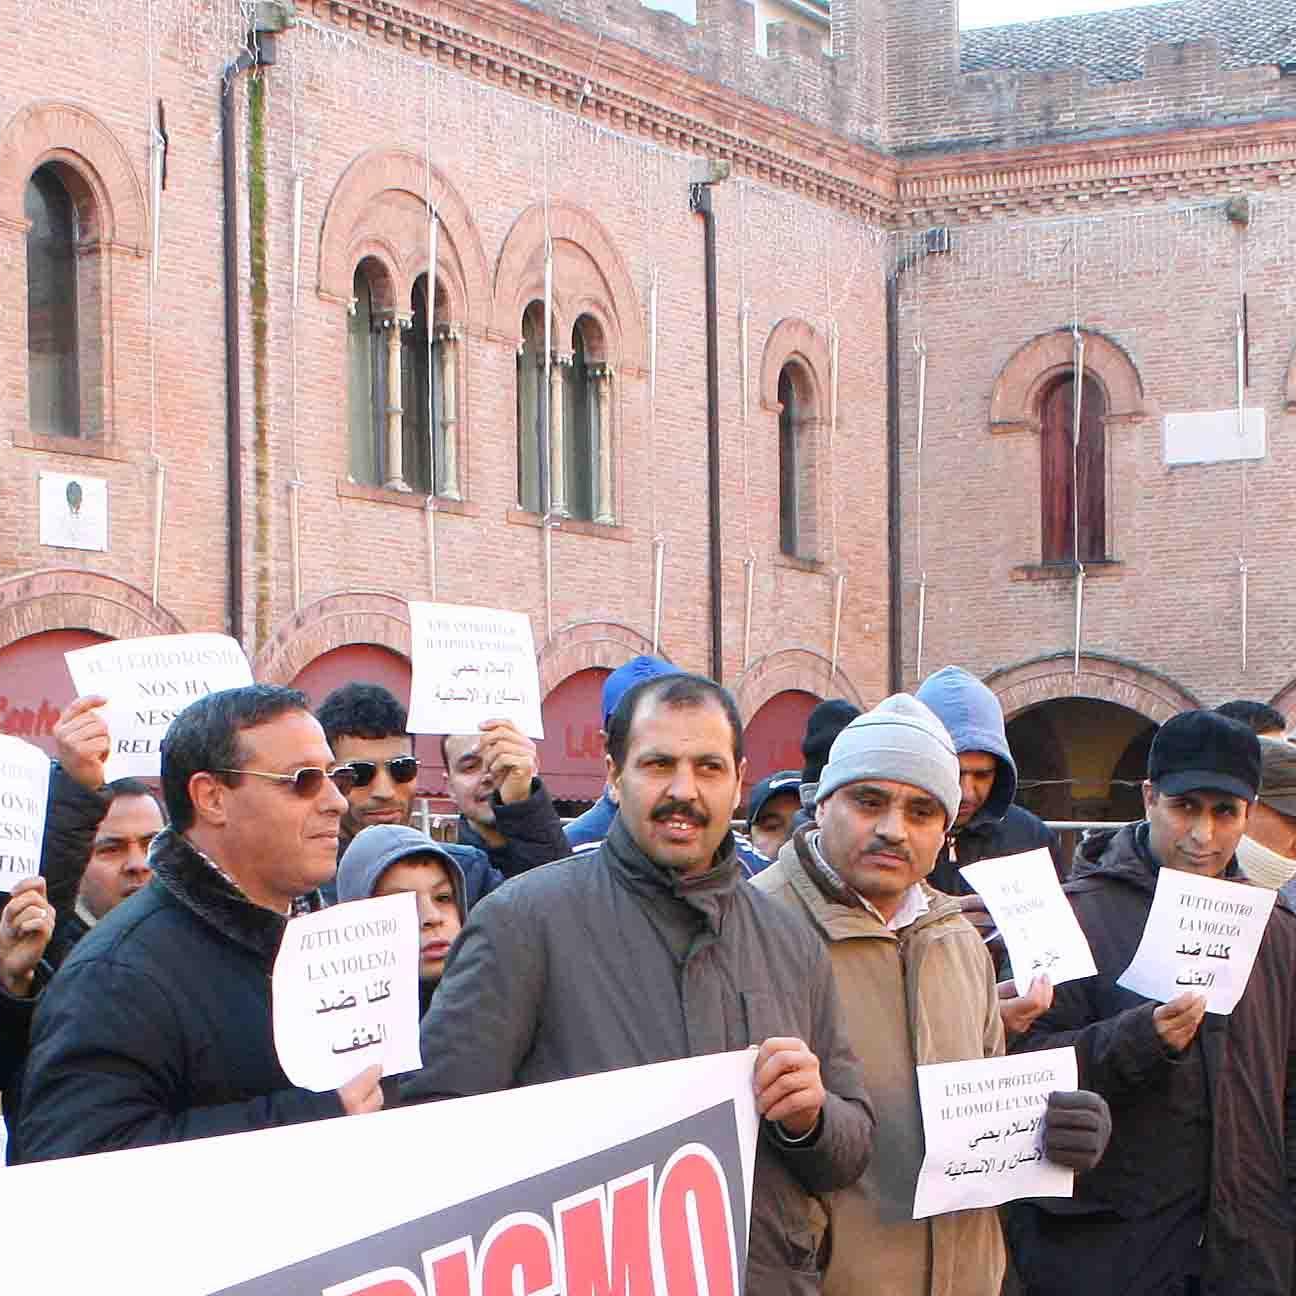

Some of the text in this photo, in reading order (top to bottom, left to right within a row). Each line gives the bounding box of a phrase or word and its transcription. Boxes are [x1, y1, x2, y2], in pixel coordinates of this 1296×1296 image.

[136, 680, 179, 697] NON
[1179, 893, 1253, 918] TUTTI CONTRO
[300, 917, 398, 951] TUTTI CONTRO
[1178, 916, 1241, 938] LA VIOLENZA
[1176, 941, 1202, 957] ضد
[307, 949, 397, 982] LA VIOLENZA
[316, 979, 392, 1015] كلنا ضد
[945, 1079, 995, 1097] L'ISLAM
